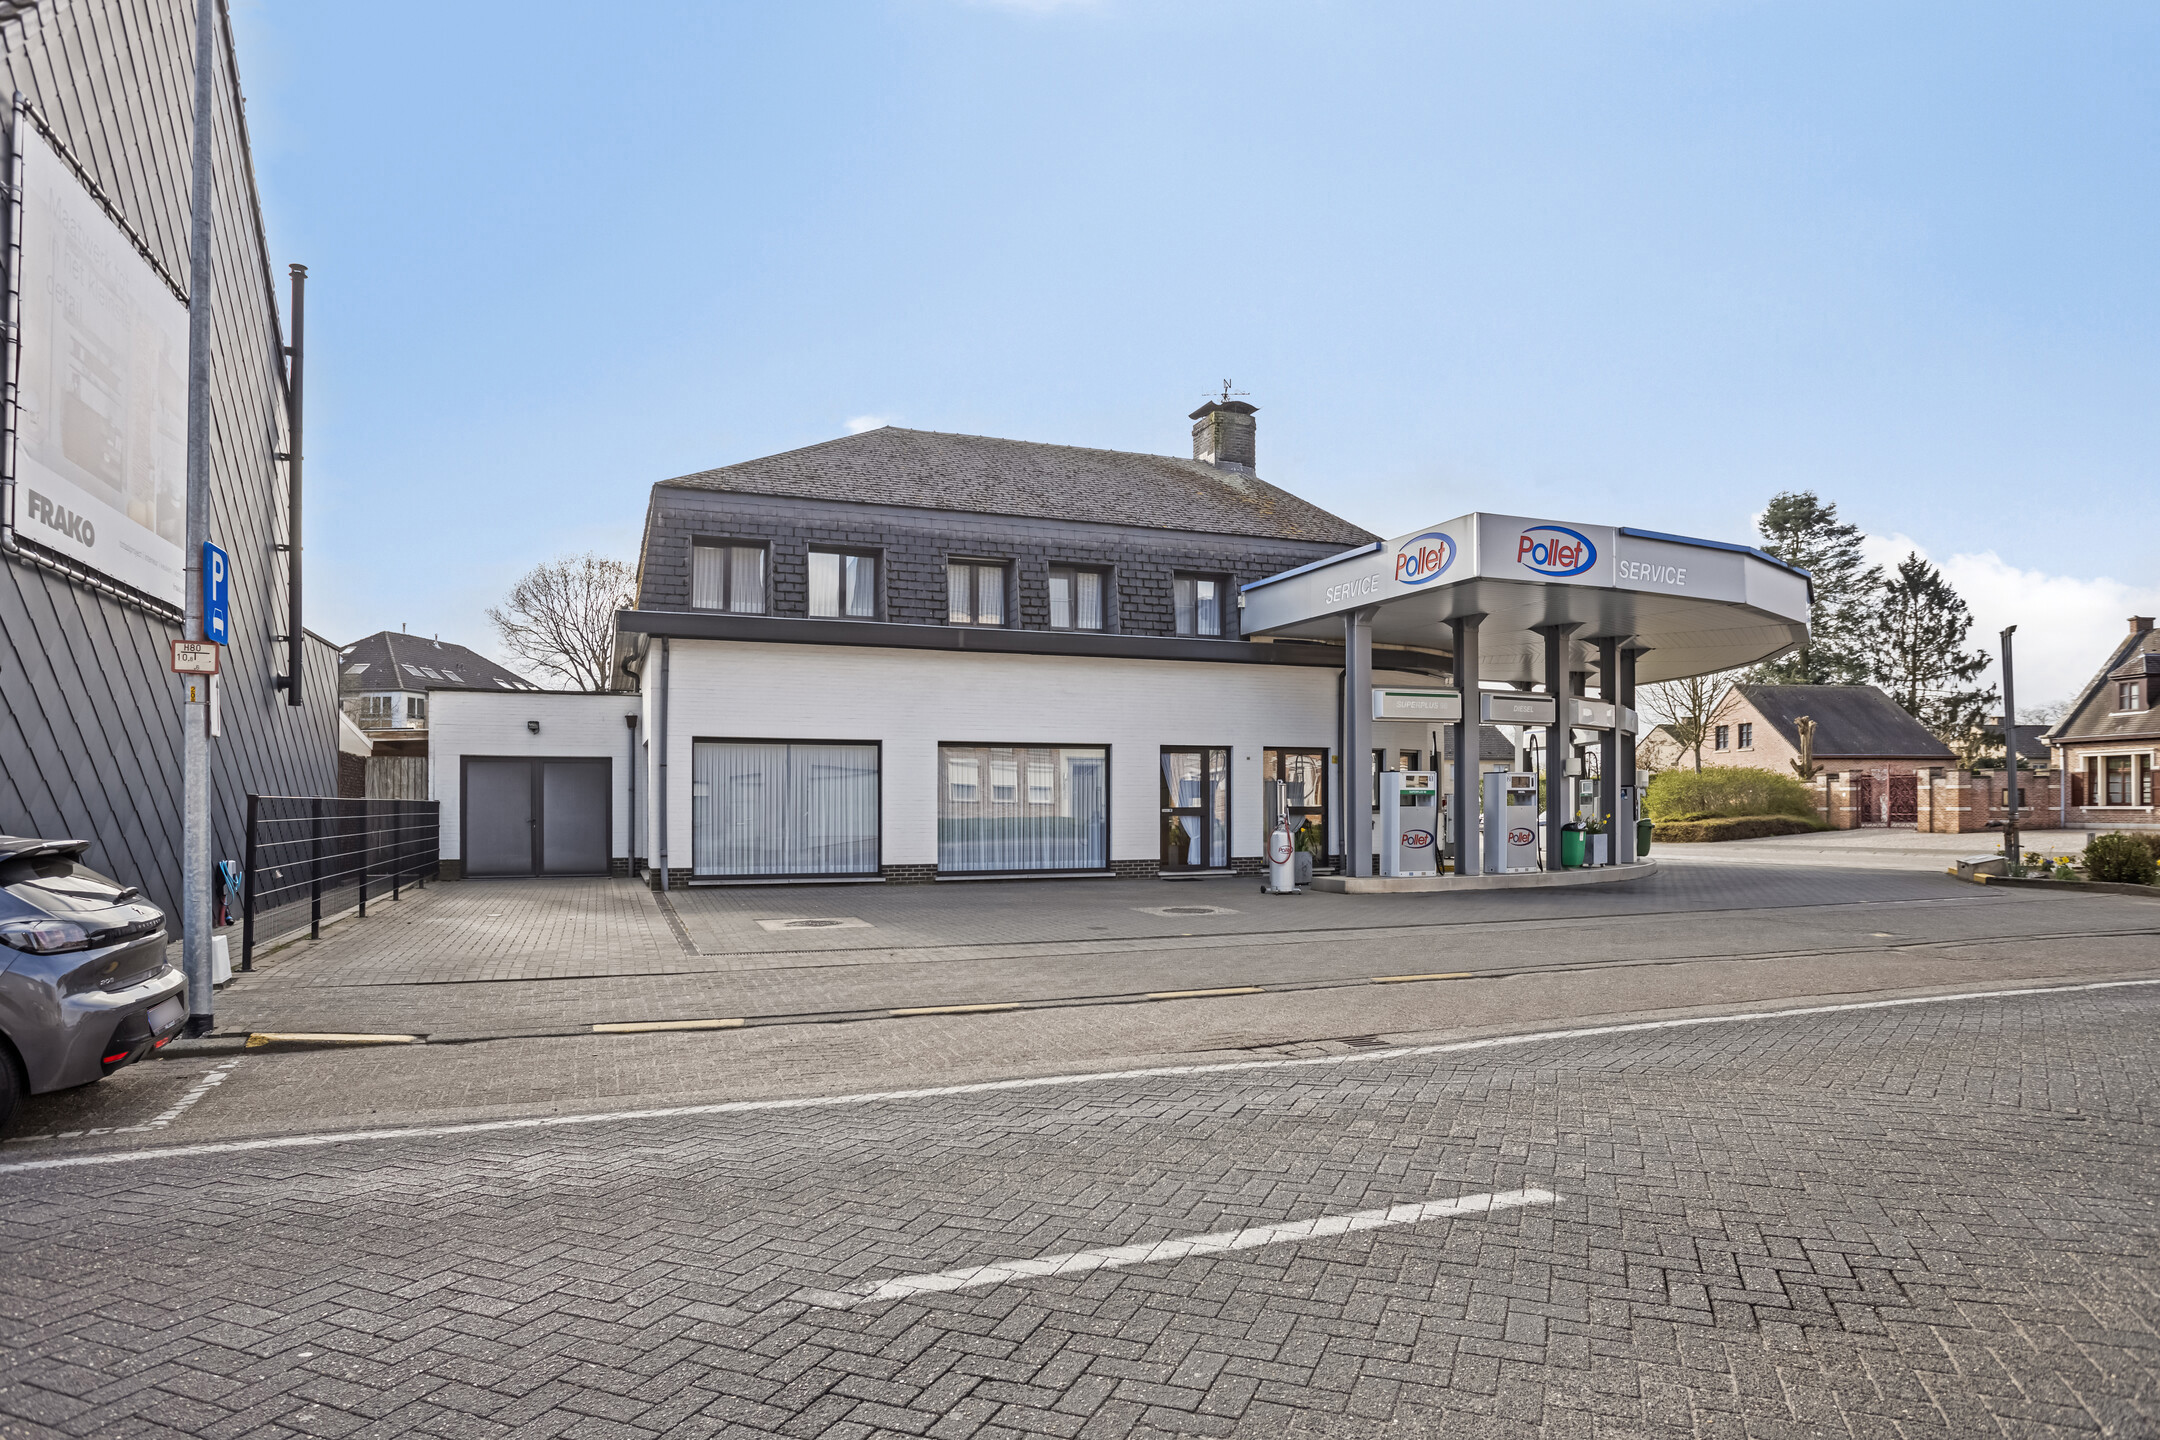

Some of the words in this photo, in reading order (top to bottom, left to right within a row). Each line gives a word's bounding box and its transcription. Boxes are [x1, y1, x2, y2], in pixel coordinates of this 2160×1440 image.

[49, 187, 111, 272] Maatwerk
[28, 487, 96, 548] FRAKO
[212, 550, 225, 602] P
[1324, 572, 1380, 606] SERVICE
[1395, 540, 1447, 583] Pollet
[1517, 535, 1583, 568] Pollet
[1618, 560, 1687, 586] SERVICE
[184, 644, 202, 653] H80
[1396, 700, 1439, 709] SUPERPLUS
[1513, 705, 1534, 713] DIESEL
[1401, 833, 1430, 846] Pollet
[1507, 832, 1531, 843] Pollet
